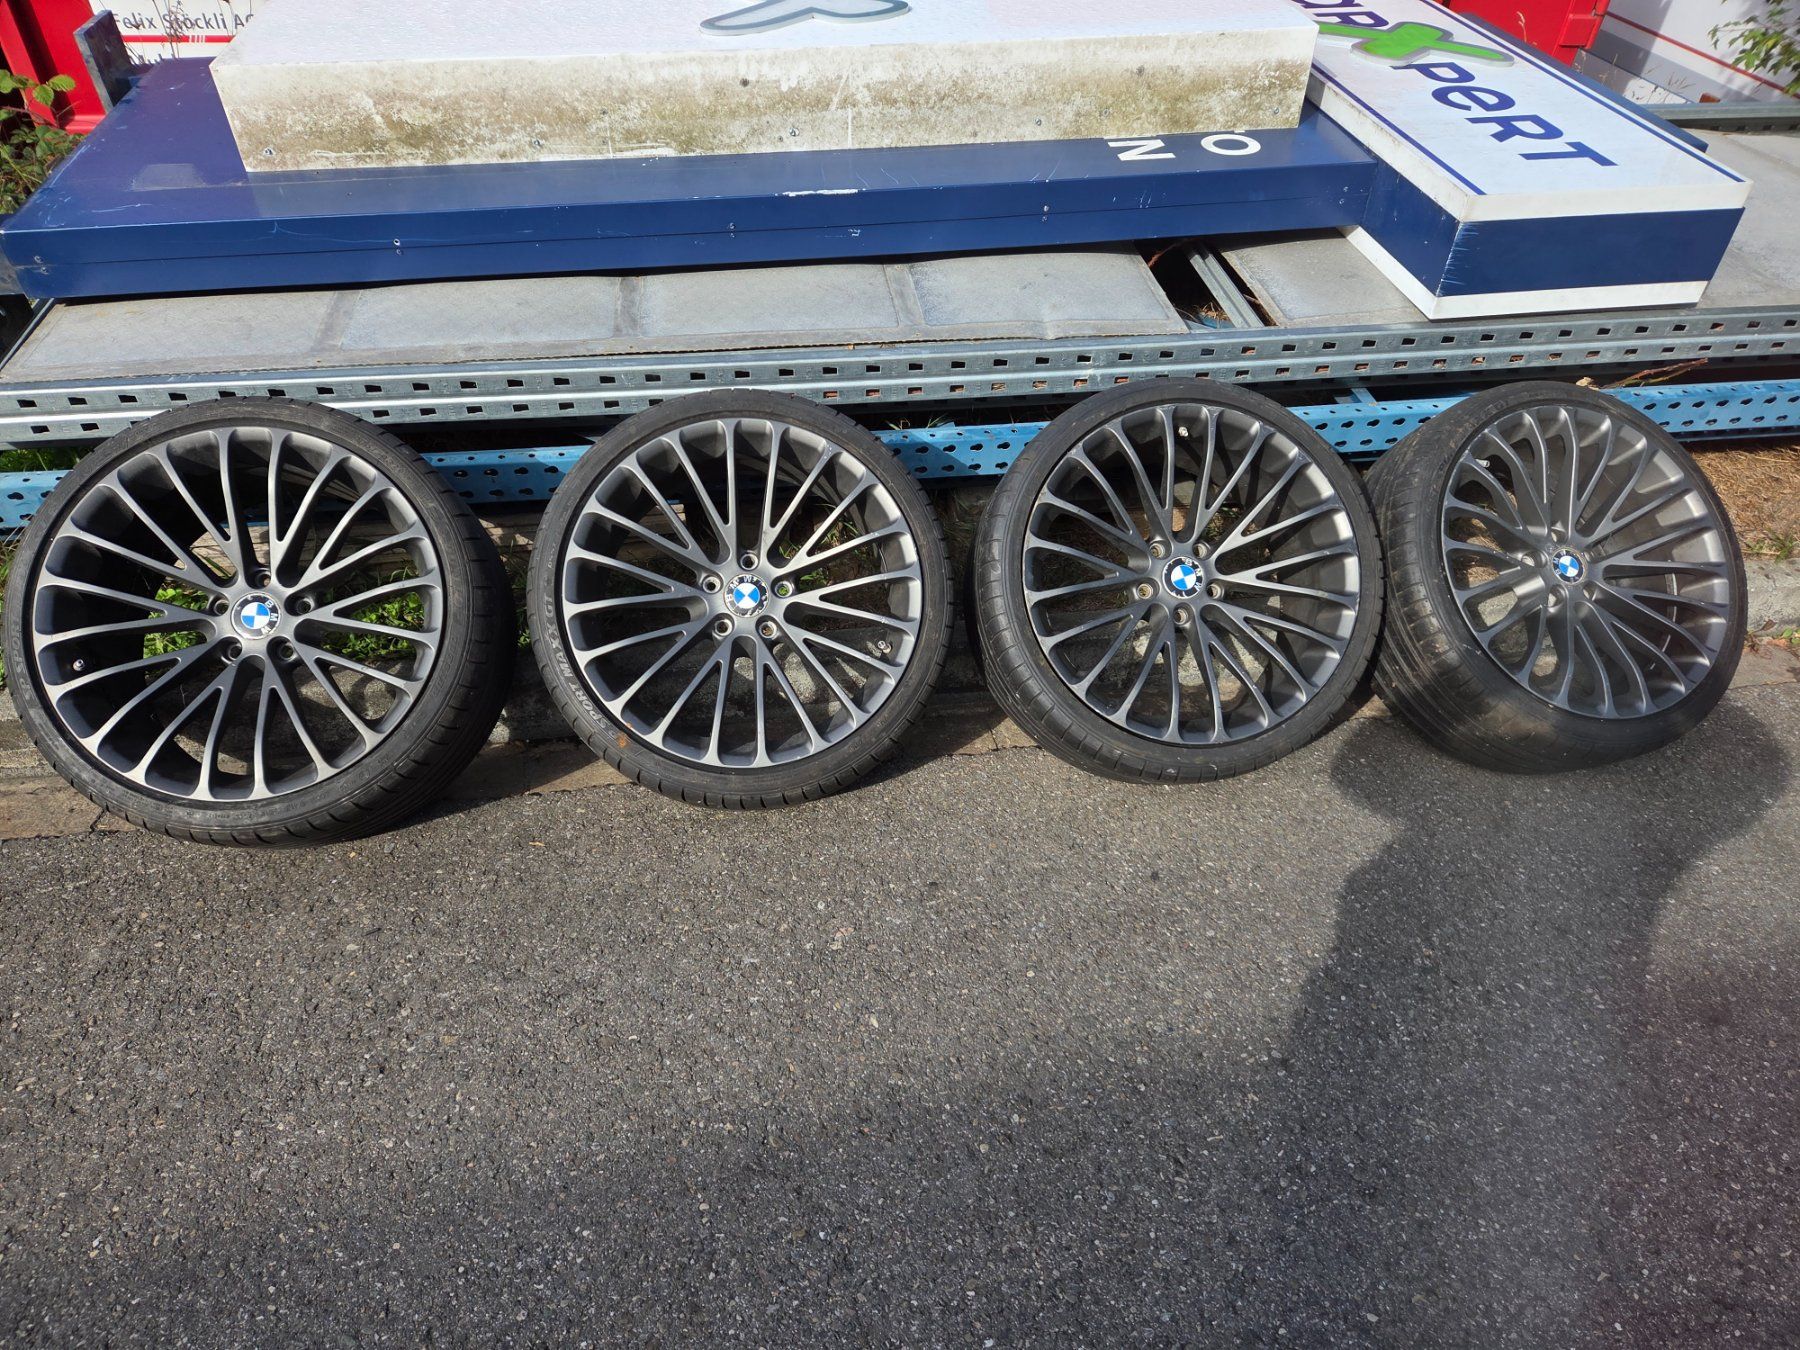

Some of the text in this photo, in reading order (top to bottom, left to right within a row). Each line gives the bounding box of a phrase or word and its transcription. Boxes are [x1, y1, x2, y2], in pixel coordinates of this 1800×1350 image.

[162, 13, 228, 30] Stöckli
[544, 592, 555, 618] GT
[546, 622, 574, 679] MAXX
[570, 681, 609, 730] SPORT
